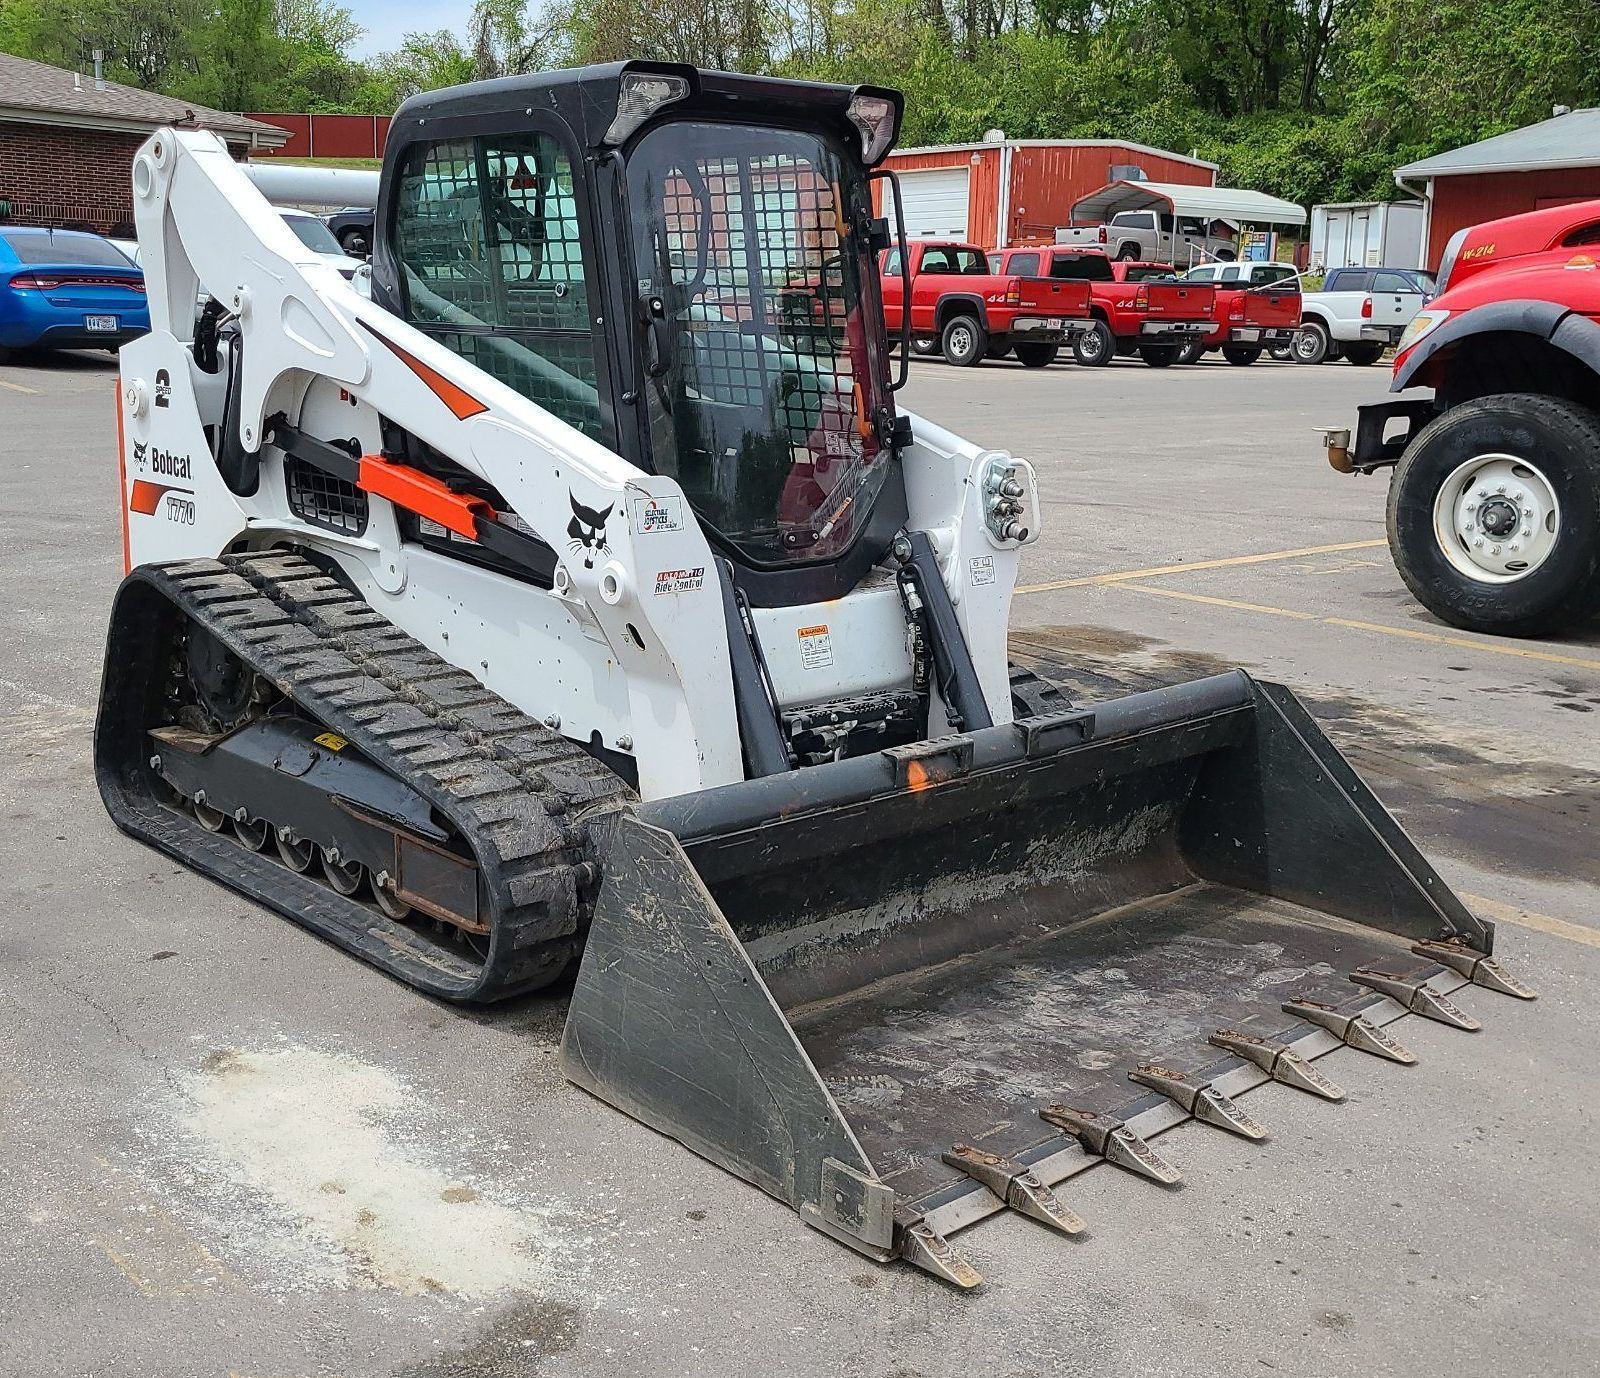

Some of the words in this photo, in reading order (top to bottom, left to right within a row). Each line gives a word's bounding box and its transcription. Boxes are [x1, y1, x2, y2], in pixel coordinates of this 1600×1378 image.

[1463, 243, 1496, 260] W-214
[154, 368, 171, 408] 2
[155, 386, 172, 395] SPEED
[152, 447, 193, 481] Bobcat
[166, 496, 196, 526] T770
[656, 567, 705, 582] AUTOMATIC
[654, 581, 672, 594] Ride
[673, 577, 703, 591] Control
